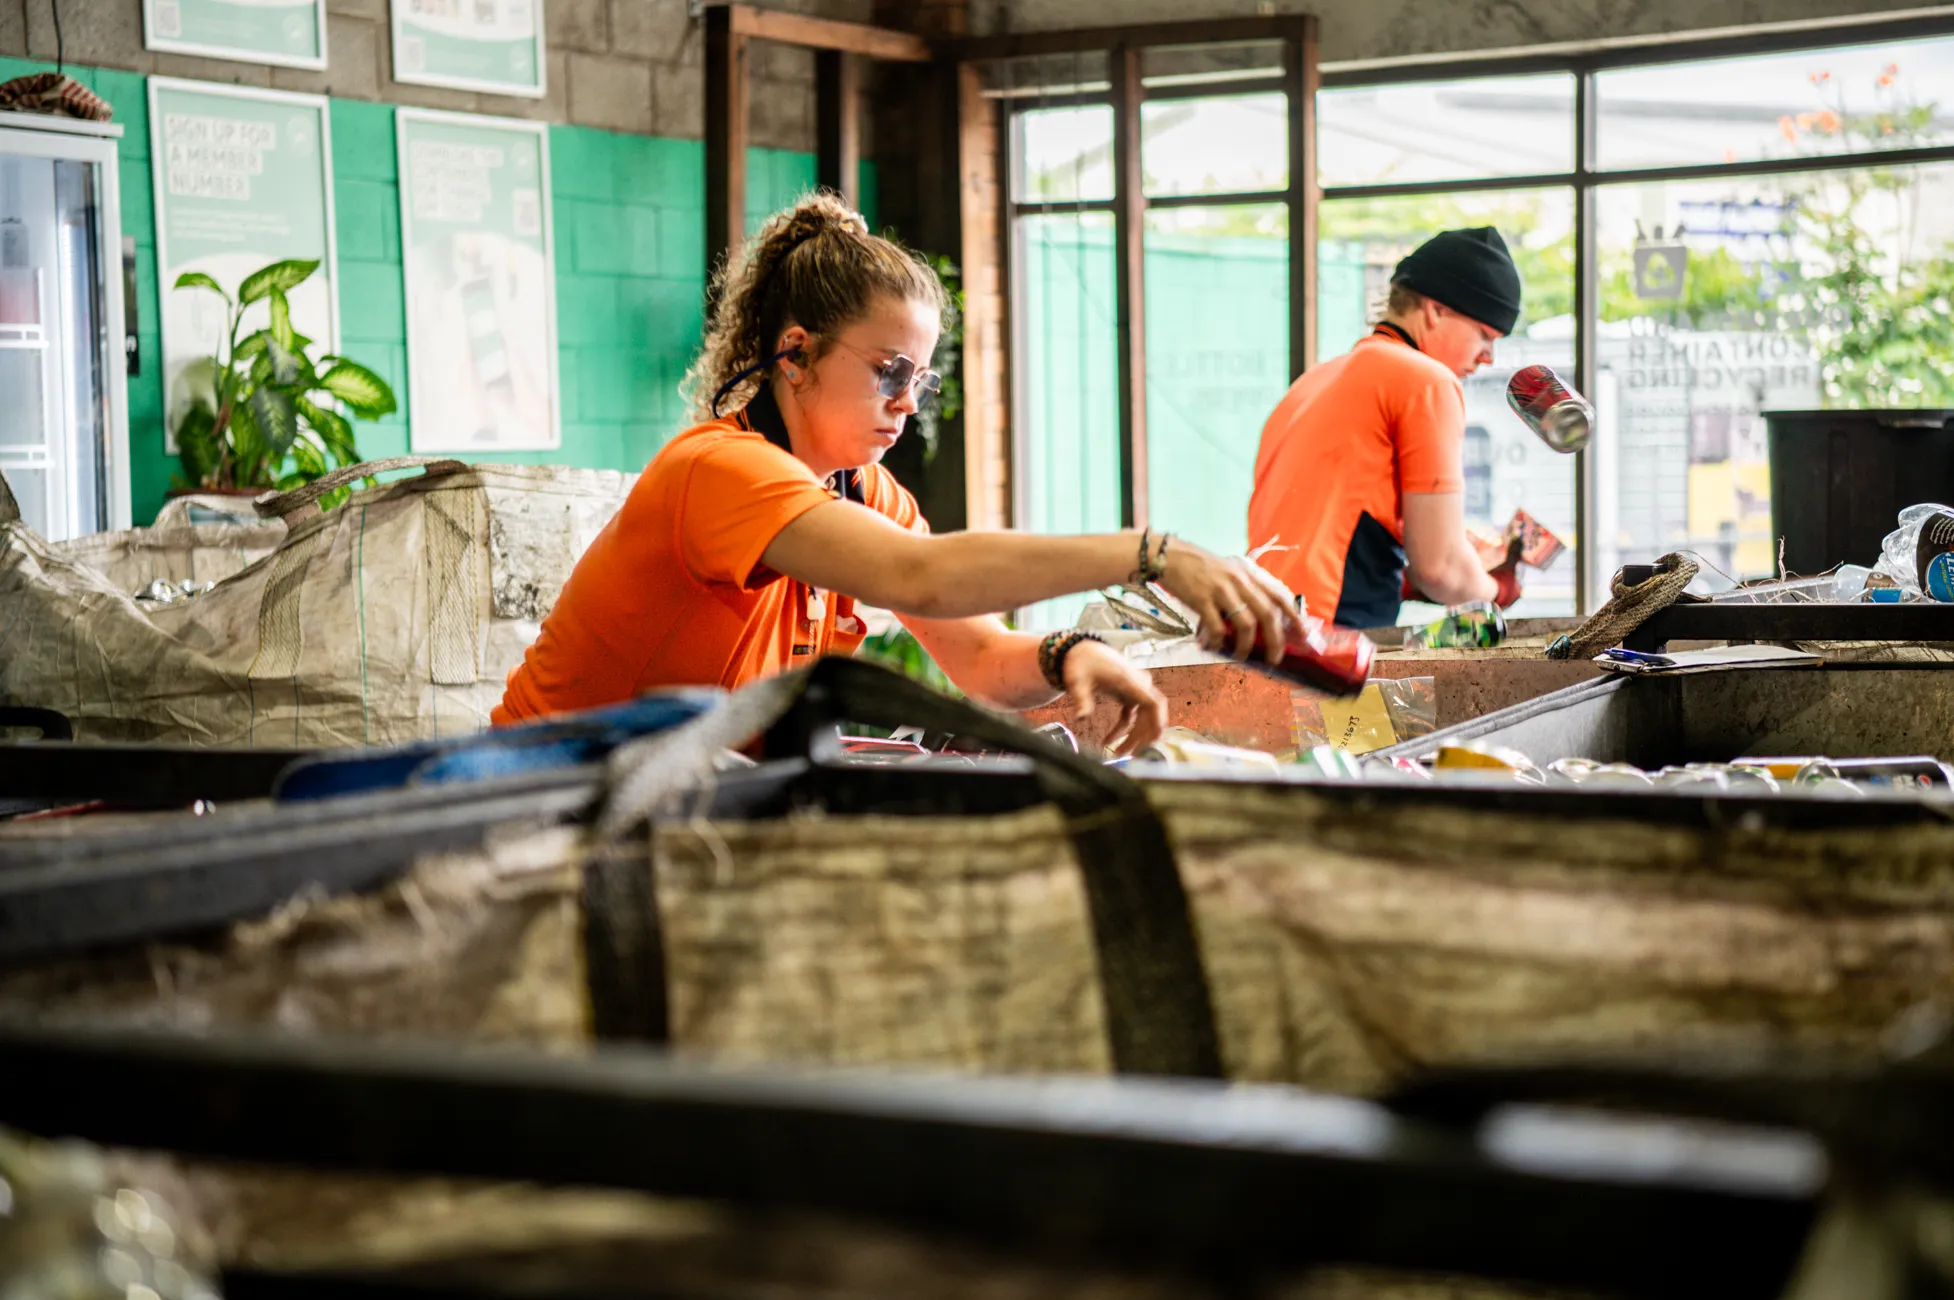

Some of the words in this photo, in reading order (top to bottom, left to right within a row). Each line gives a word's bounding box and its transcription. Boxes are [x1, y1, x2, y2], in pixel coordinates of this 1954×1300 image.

[168, 116, 207, 139] SIGN
[212, 118, 235, 141] UP
[240, 122, 270, 144] FOR
[170, 143, 182, 163] A
[187, 145, 257, 171] MEMBER
[171, 171, 245, 197] NUMBER
